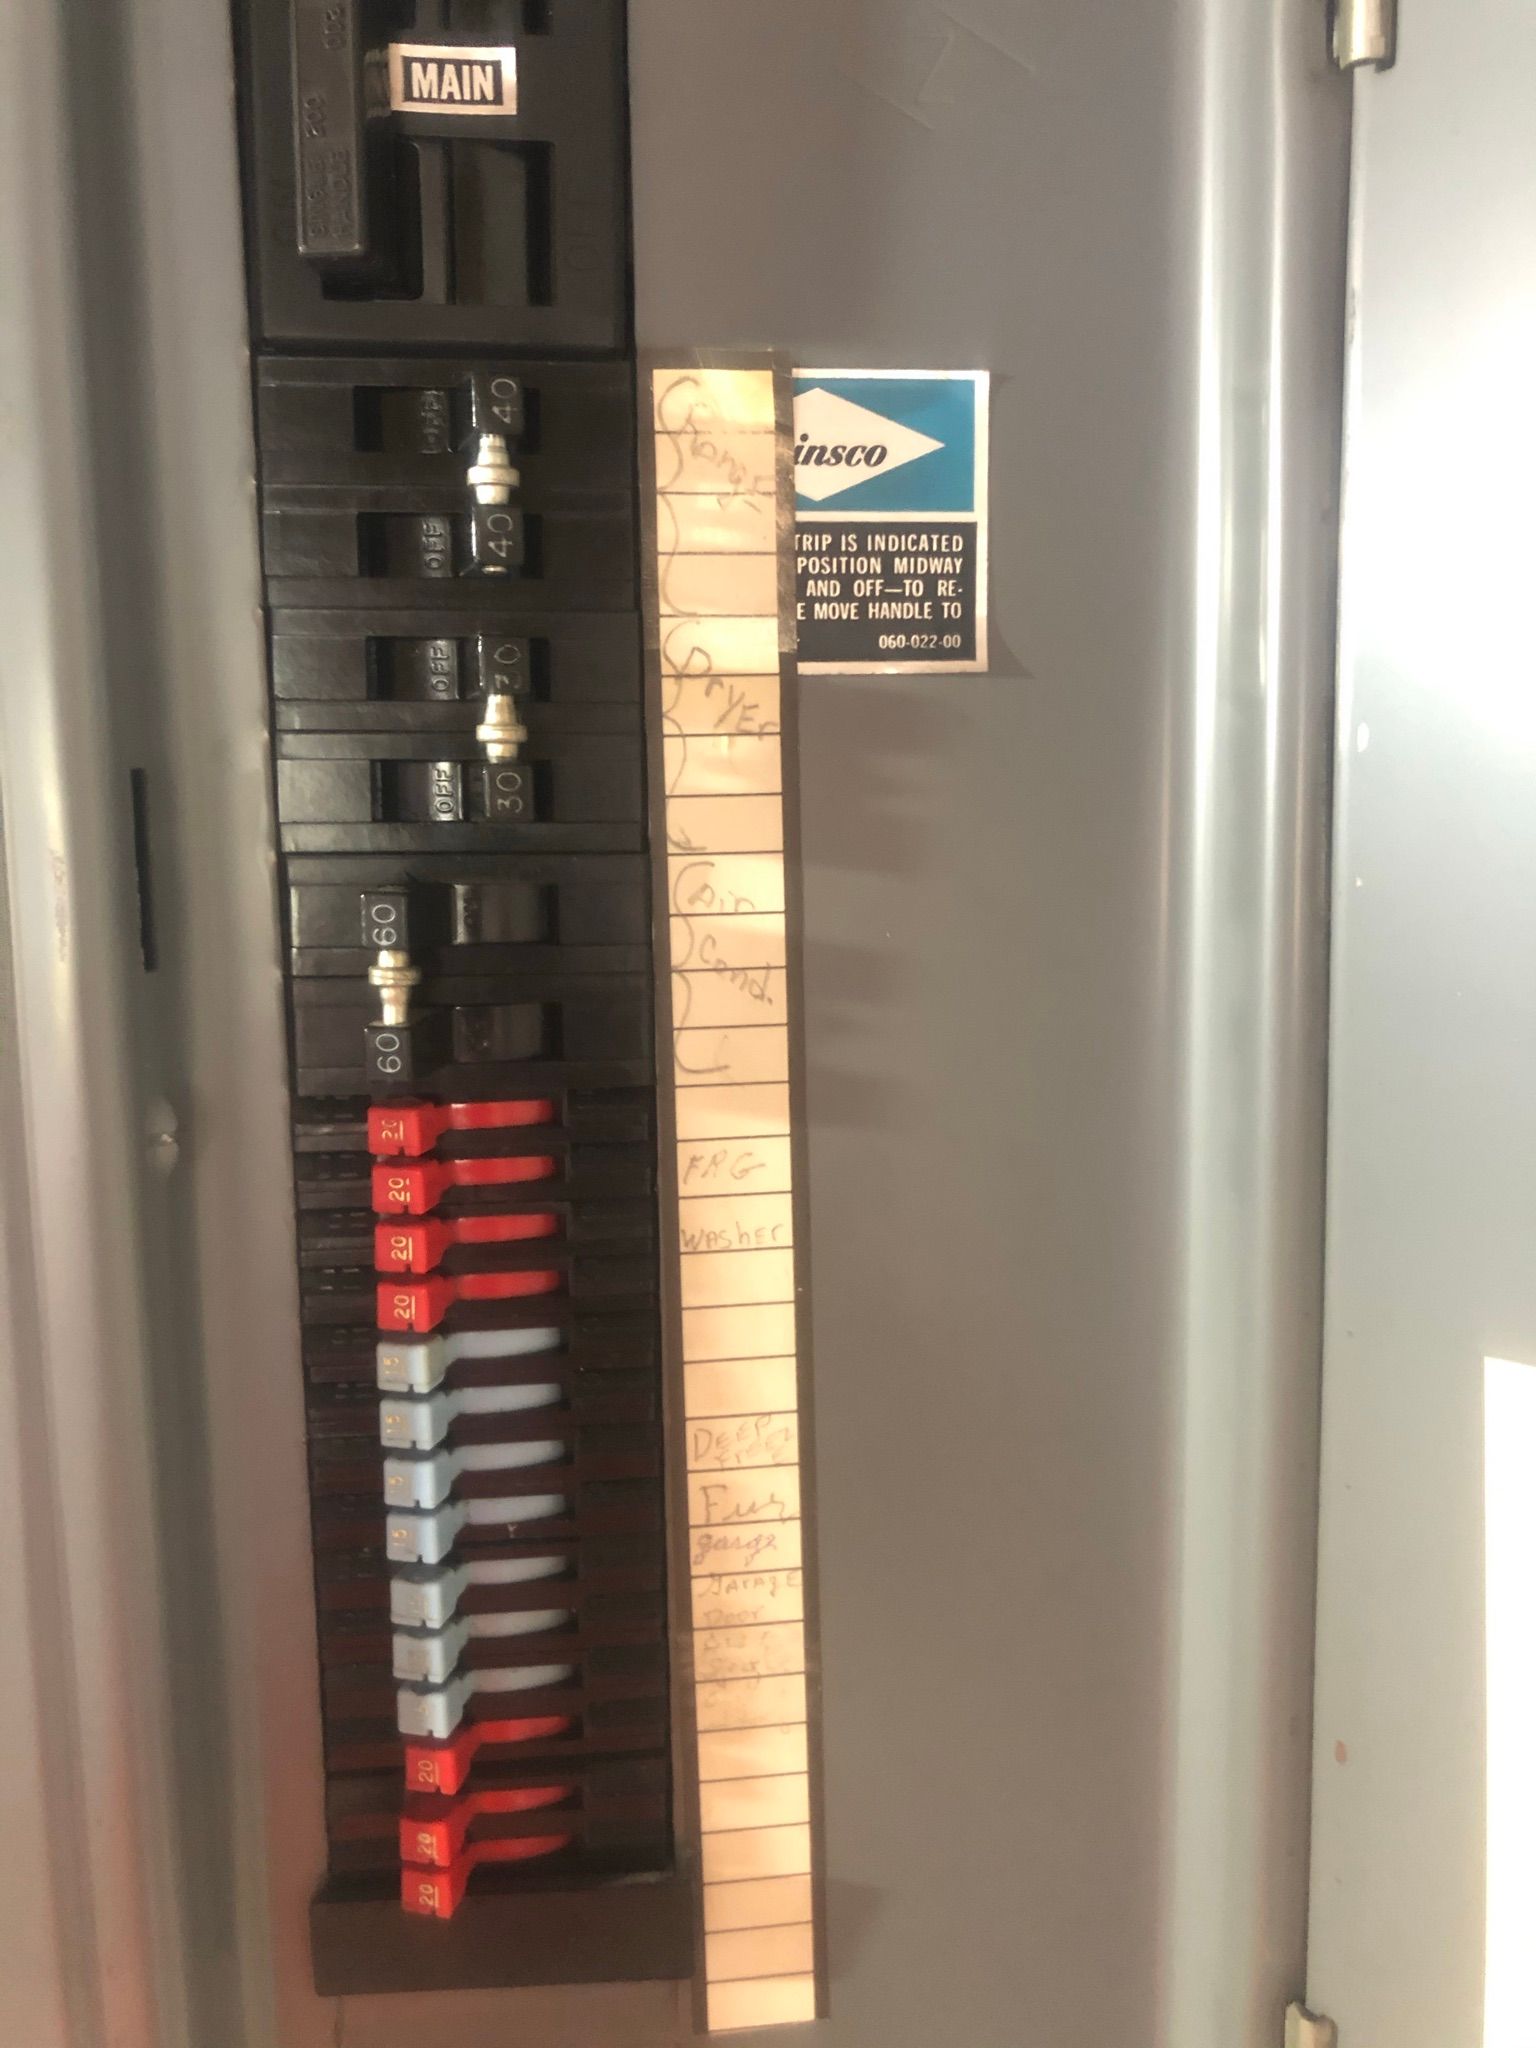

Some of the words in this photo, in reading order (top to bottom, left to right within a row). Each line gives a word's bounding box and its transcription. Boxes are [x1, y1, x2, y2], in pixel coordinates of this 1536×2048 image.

[410, 62, 494, 101] MAIN
[491, 376, 517, 425] 40
[424, 519, 446, 570] OFF
[487, 513, 513, 558] 40
[795, 535, 832, 552] TRIP
[841, 535, 857, 552] IS
[867, 535, 963, 552] INDICATED
[797, 557, 881, 574] POSITION
[894, 557, 963, 575] MIDWAY
[806, 580, 840, 597] AND
[937, 580, 963, 597] RE-
[814, 602, 859, 620] MOVE
[868, 602, 933, 620] HANDLE
[942, 602, 962, 619] TO
[878, 634, 962, 649] 060-022-00
[431, 645, 450, 693] OFF
[435, 768, 458, 815] OFF
[496, 771, 523, 815] 30
[371, 904, 397, 946] 60
[376, 1033, 401, 1073] 60
[388, 1177, 405, 1202] 20
[391, 1236, 407, 1261] 20
[394, 1294, 410, 1319] 20
[418, 1760, 434, 1783] 20
[417, 1832, 433, 1856] 20
[419, 1884, 435, 1906] 20
